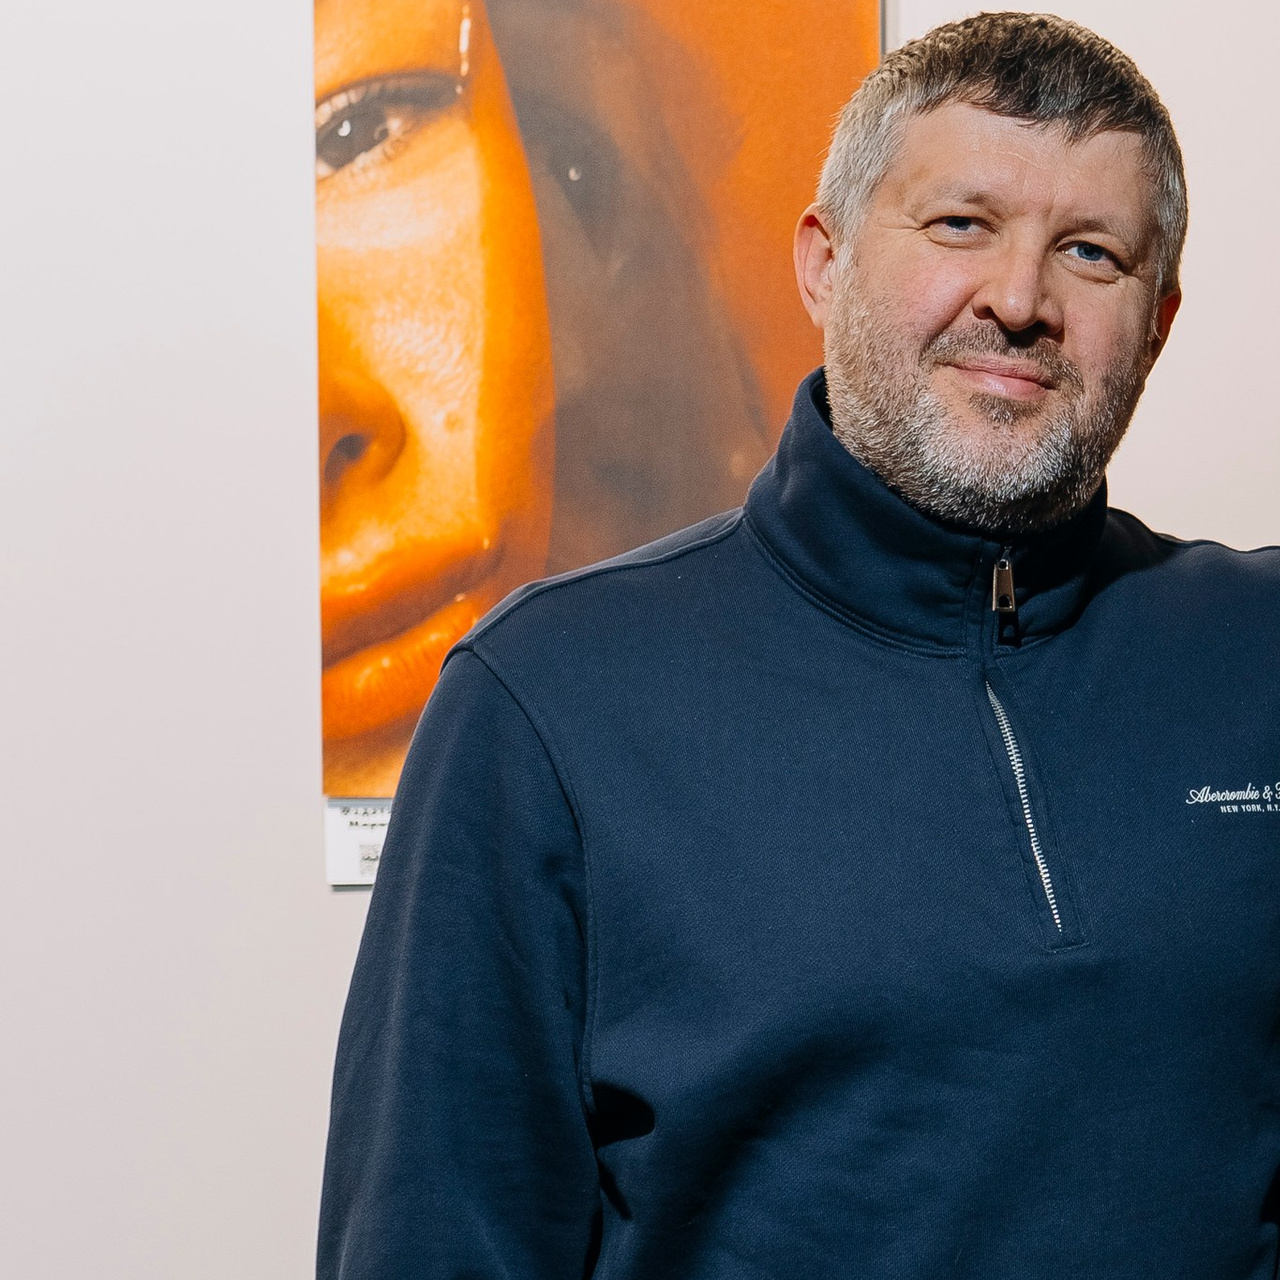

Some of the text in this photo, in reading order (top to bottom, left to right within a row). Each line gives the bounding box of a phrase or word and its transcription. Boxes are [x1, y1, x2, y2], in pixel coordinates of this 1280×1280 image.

[1185, 782, 1260, 805] Abercrombie
[1262, 785, 1273, 802] &
[1220, 803, 1280, 813] NEW YORK, N.Y.
